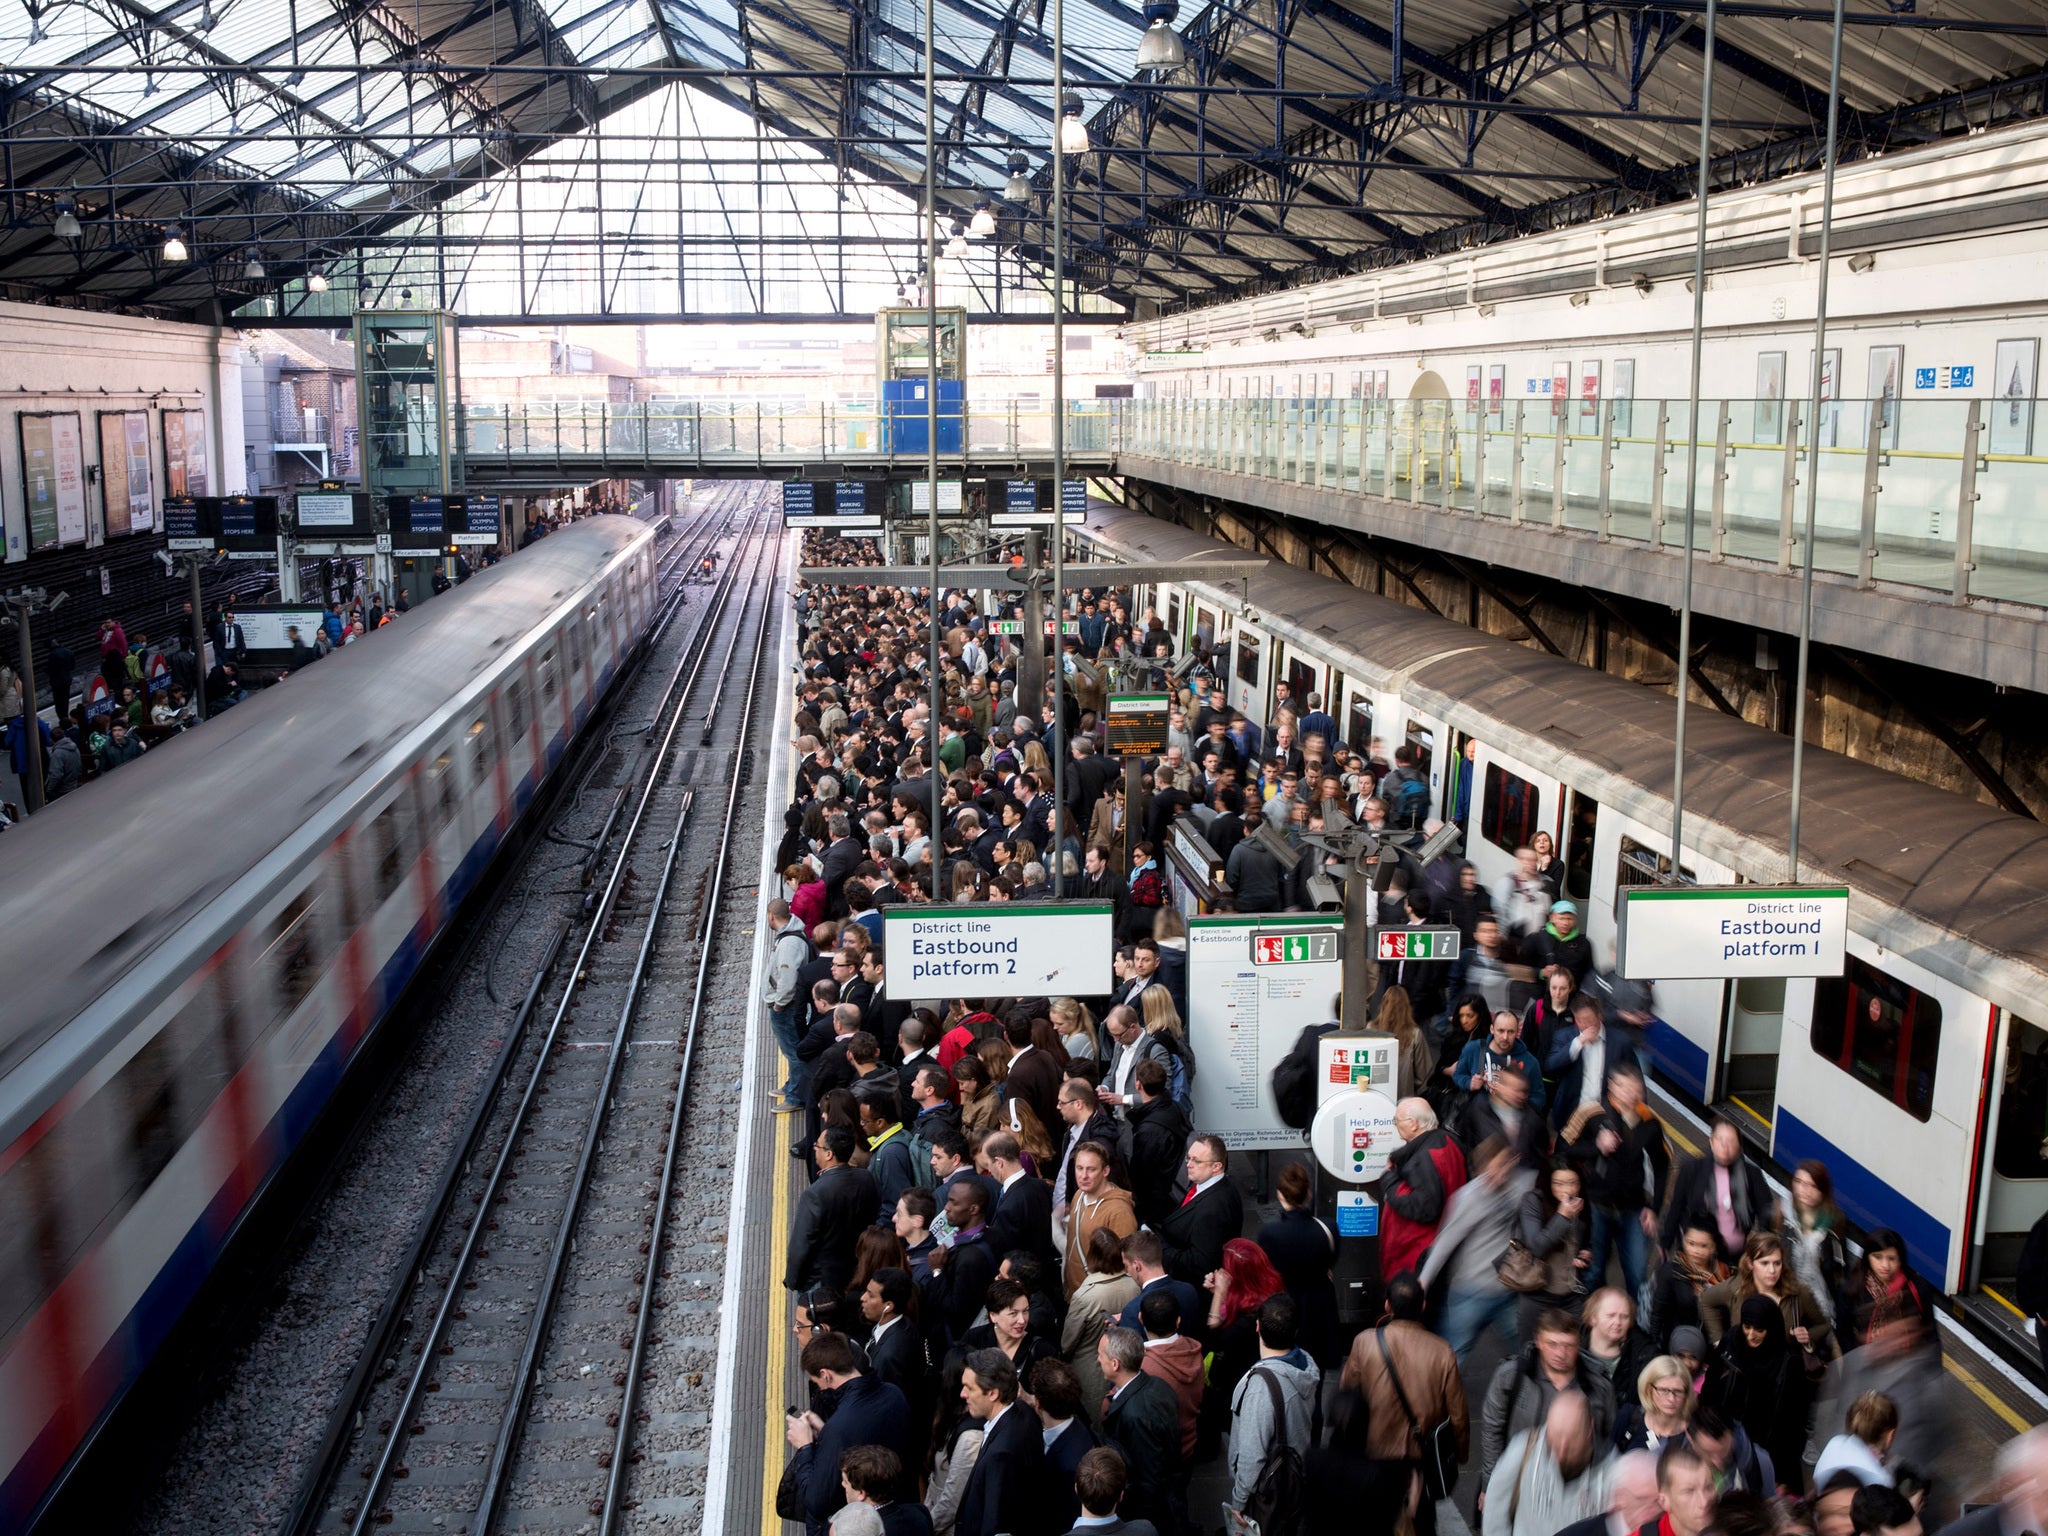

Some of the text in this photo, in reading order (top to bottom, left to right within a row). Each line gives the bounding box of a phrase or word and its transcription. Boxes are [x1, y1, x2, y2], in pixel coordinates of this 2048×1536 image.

[1747, 902, 1822, 914] District line
[912, 921, 991, 934] District line
[1721, 918, 1821, 935] Eastbound
[912, 937, 1018, 955] Eastbound
[1723, 941, 1806, 960] platform
[913, 958, 1016, 980] platform 2
[1350, 1119, 1371, 1128] Help
